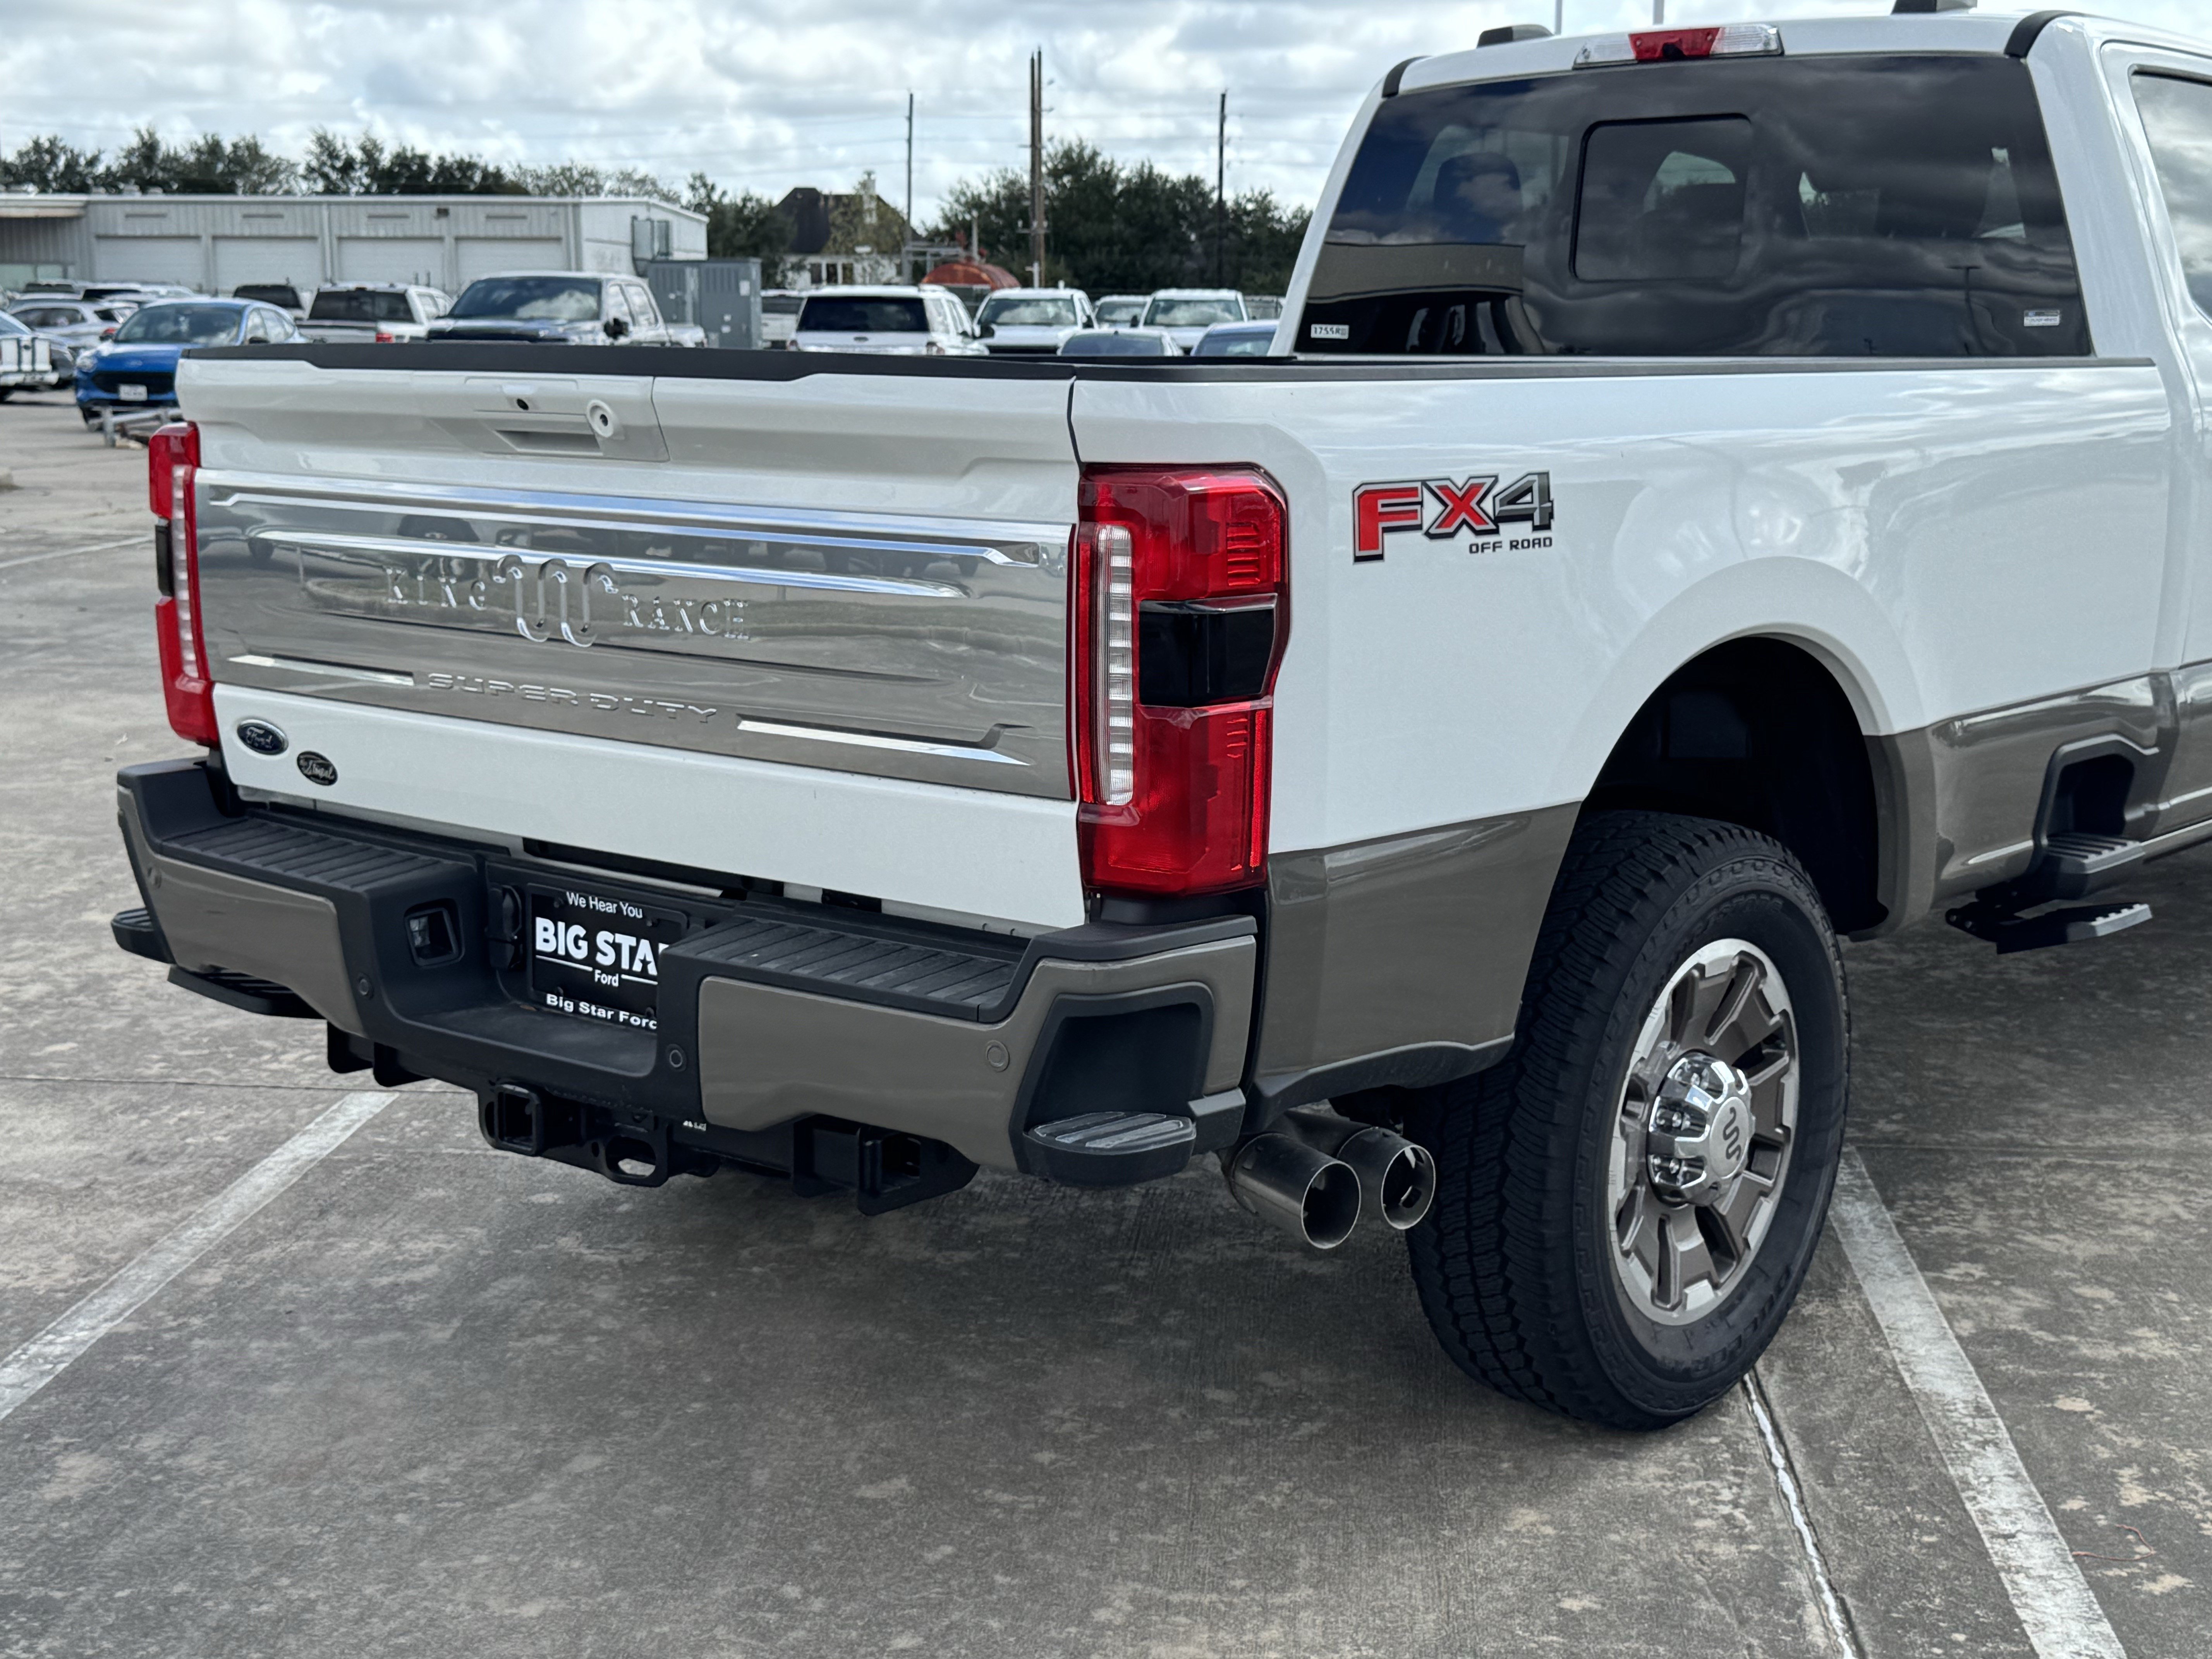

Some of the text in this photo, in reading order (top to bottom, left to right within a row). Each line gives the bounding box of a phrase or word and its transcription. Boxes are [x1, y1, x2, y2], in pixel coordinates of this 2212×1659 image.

[1352, 470, 1554, 564] FX4
[1469, 537, 1553, 554] OFF ROAD
[386, 568, 750, 640] KING RANCH
[428, 673, 718, 724] SUPER DUTY
[566, 891, 643, 919] We Hear You
[536, 917, 669, 976] BIG STA
[594, 969, 619, 987] Ford
[546, 994, 574, 1013] Big
[579, 1001, 614, 1019] Star
